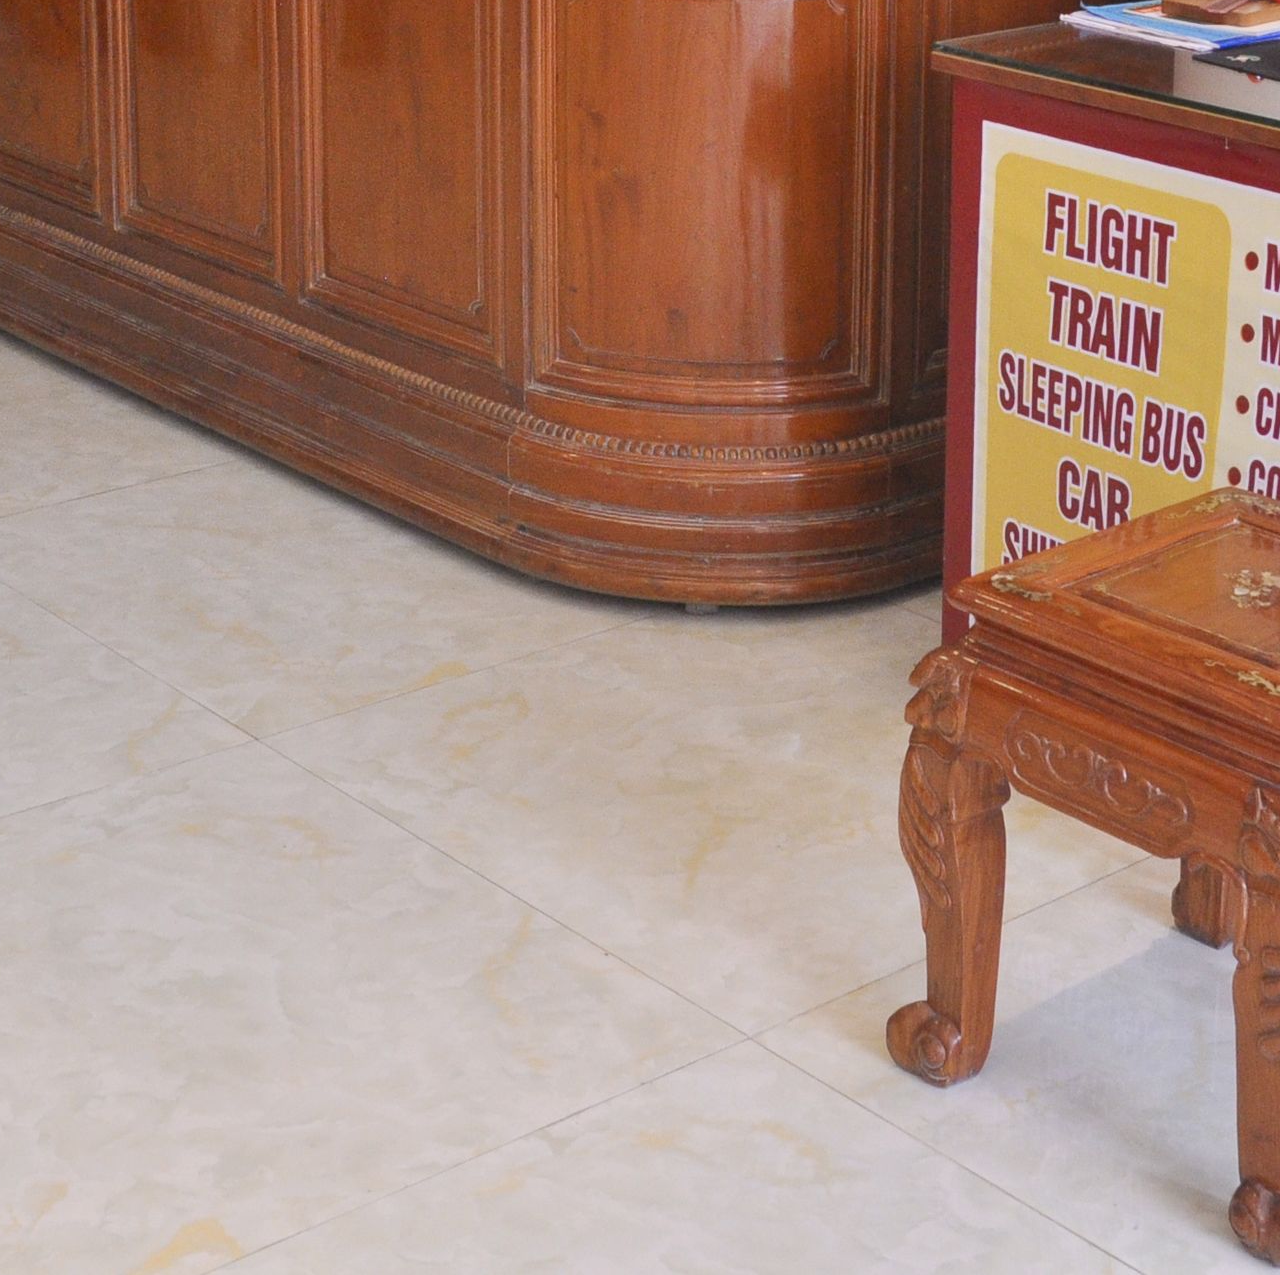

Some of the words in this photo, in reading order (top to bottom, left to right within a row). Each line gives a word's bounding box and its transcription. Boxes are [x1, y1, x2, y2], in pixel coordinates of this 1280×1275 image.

[1044, 191, 1176, 286] FLIGHT
[1048, 279, 1162, 374] TRAIN
[998, 351, 1135, 456] SLEEPING
[1141, 400, 1206, 480] BUS
[1058, 459, 1131, 531] CAR
